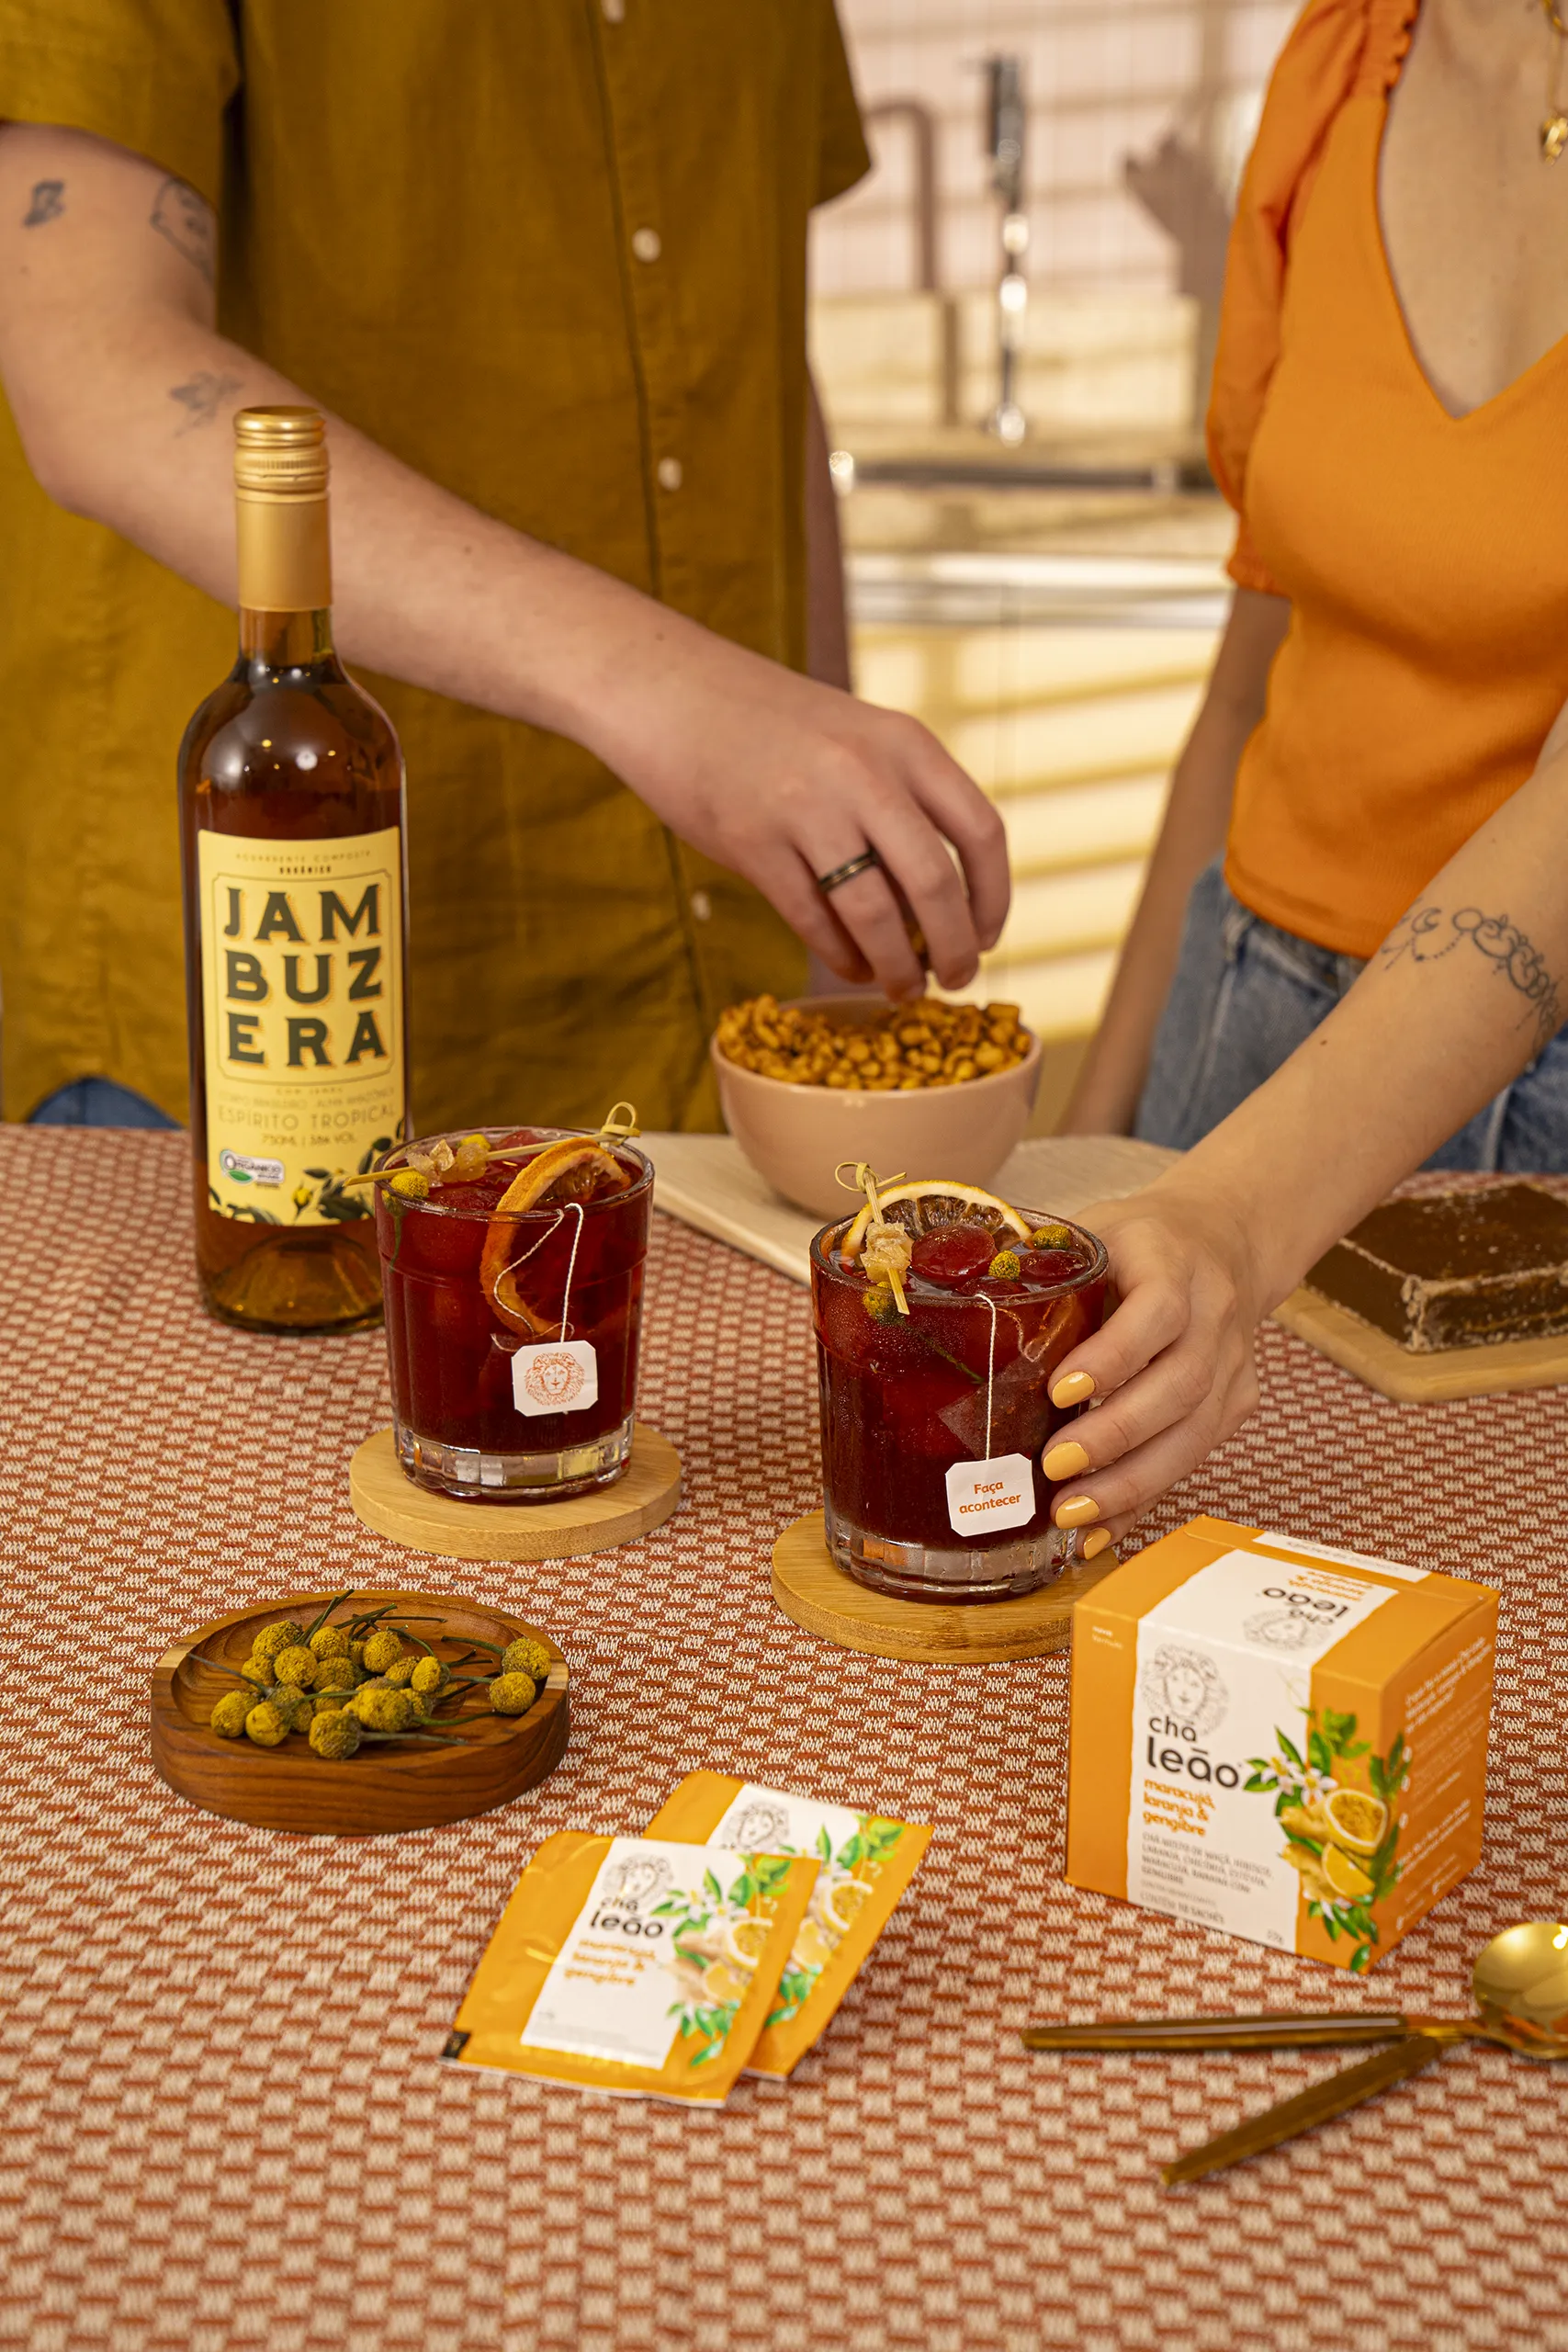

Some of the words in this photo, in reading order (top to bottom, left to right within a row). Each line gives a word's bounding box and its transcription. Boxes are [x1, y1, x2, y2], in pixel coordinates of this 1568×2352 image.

[223, 883, 382, 943] JAM
[225, 945, 384, 1004] BUZ
[227, 1010, 388, 1068] ERA
[311, 1102, 396, 1129] TROPICAL
[959, 1494, 1021, 1514] acontecer
[974, 1481, 1004, 1495] Faça
[1147, 1735, 1239, 1789] leão
